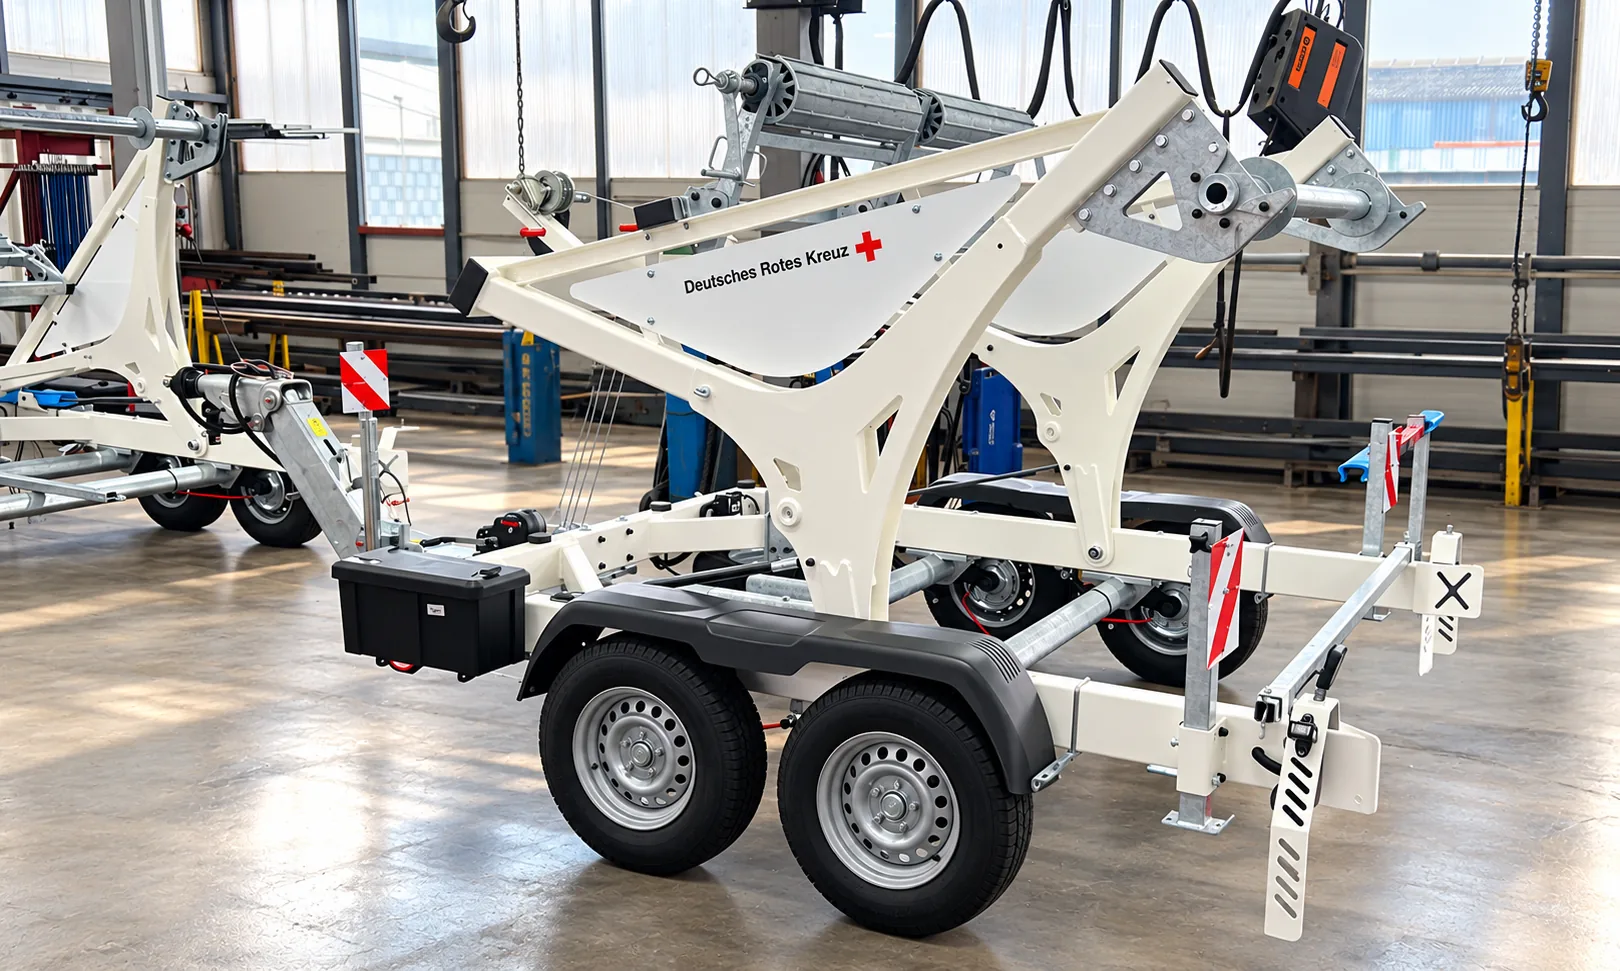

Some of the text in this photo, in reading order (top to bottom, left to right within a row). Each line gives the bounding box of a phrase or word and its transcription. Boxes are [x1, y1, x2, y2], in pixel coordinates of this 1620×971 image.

[684, 245, 849, 294] Deutsches Rotes Kreuz
